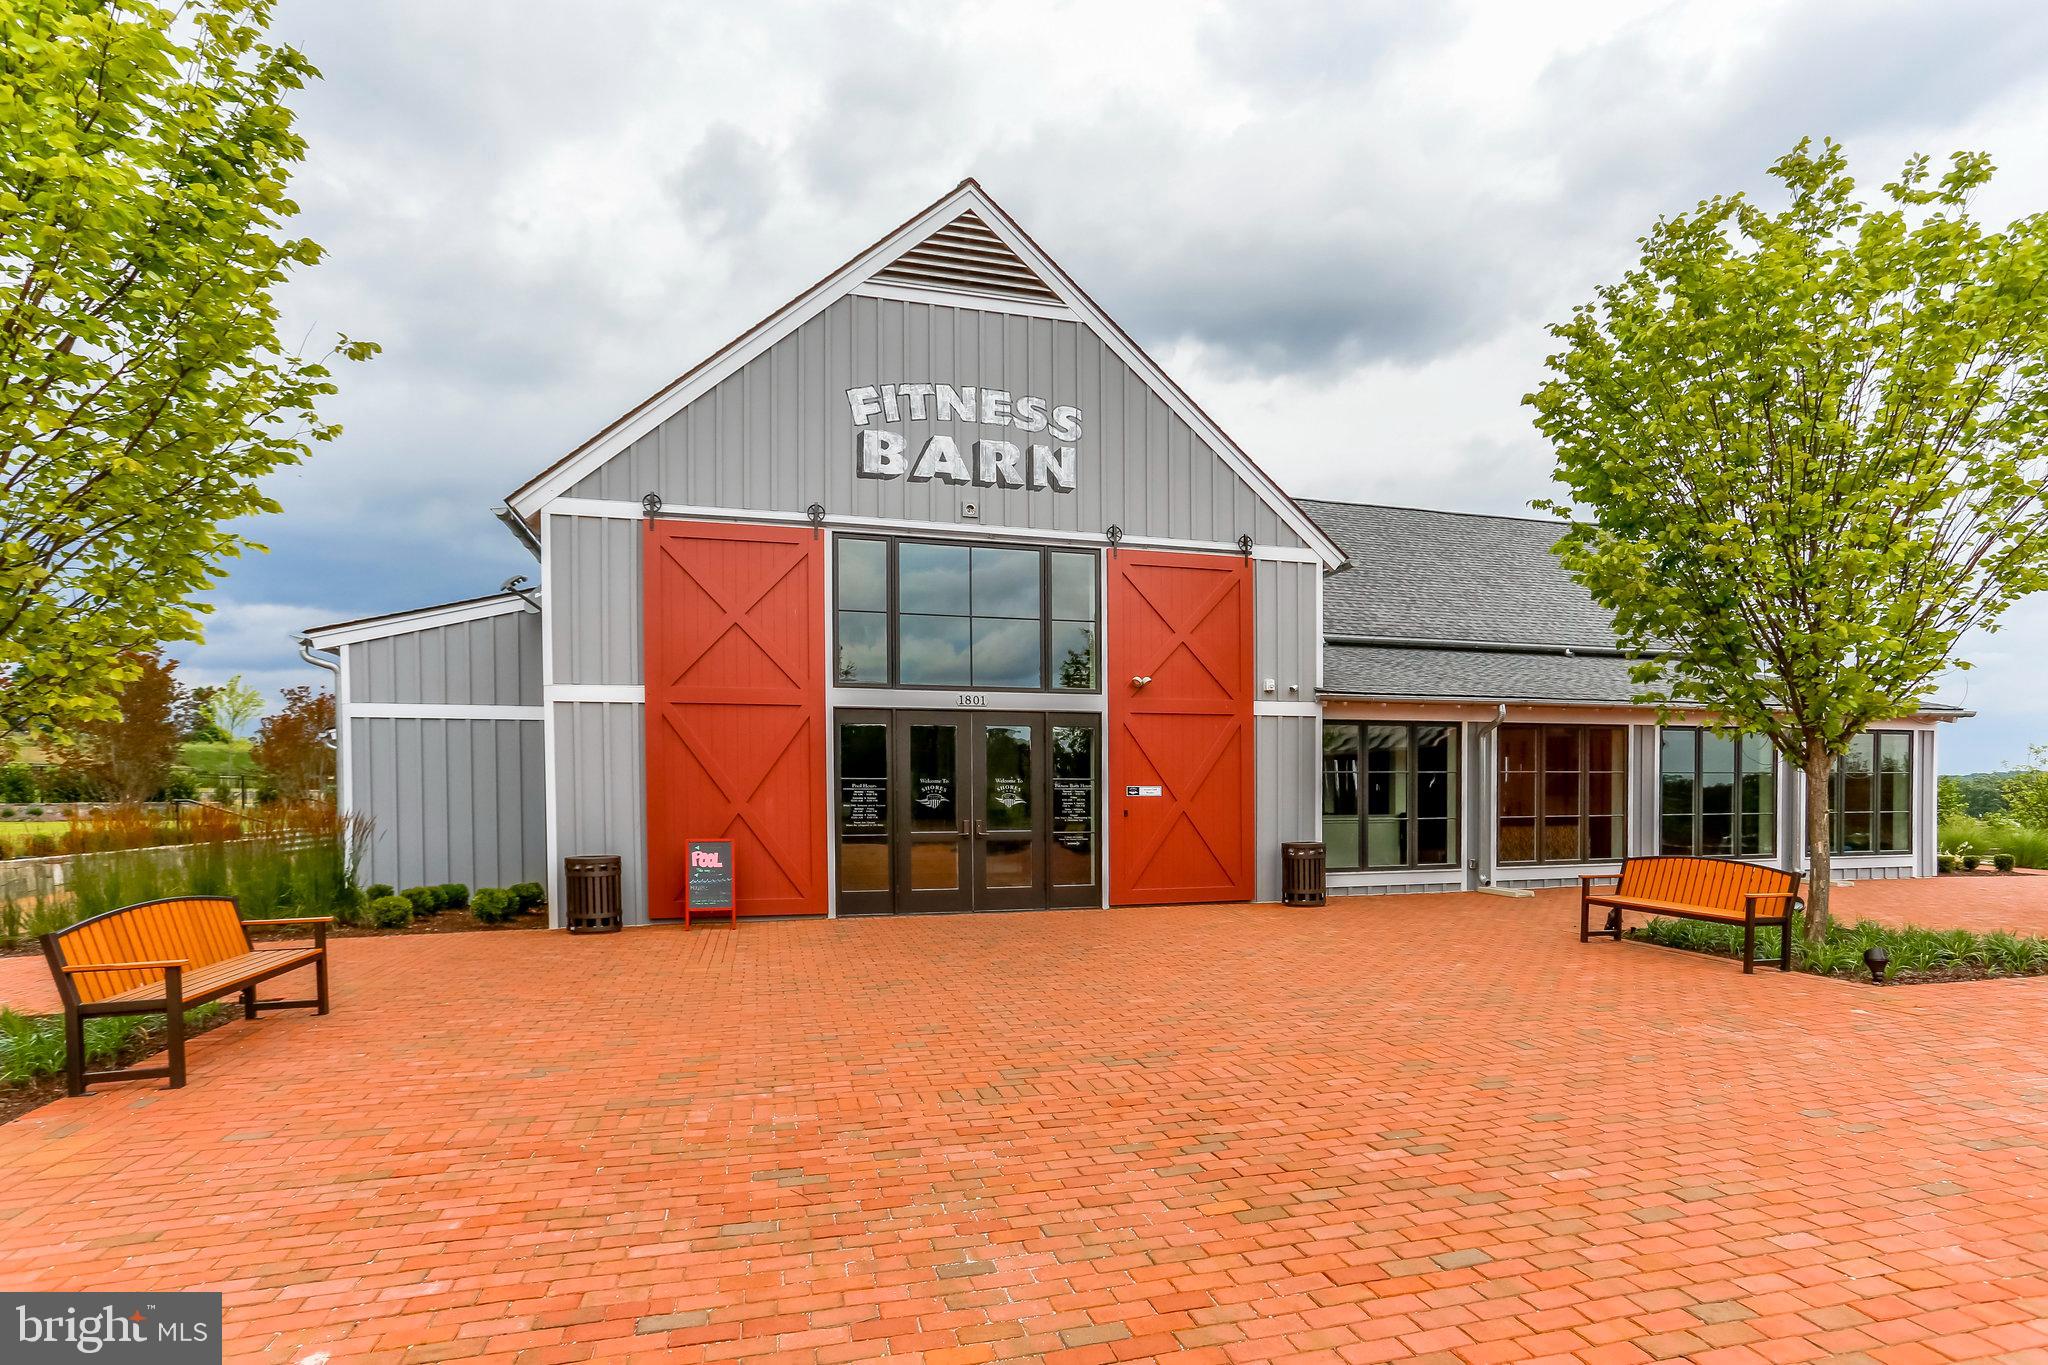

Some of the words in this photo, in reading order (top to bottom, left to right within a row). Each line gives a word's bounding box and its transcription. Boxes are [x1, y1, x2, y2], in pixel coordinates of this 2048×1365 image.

[846, 383, 1083, 442] FITNESS
[856, 429, 1077, 494] BARN
[958, 694, 986, 706] 1801
[921, 784, 947, 792] SHORES
[996, 784, 1021, 792] SHORES
[691, 851, 723, 868] POOL
